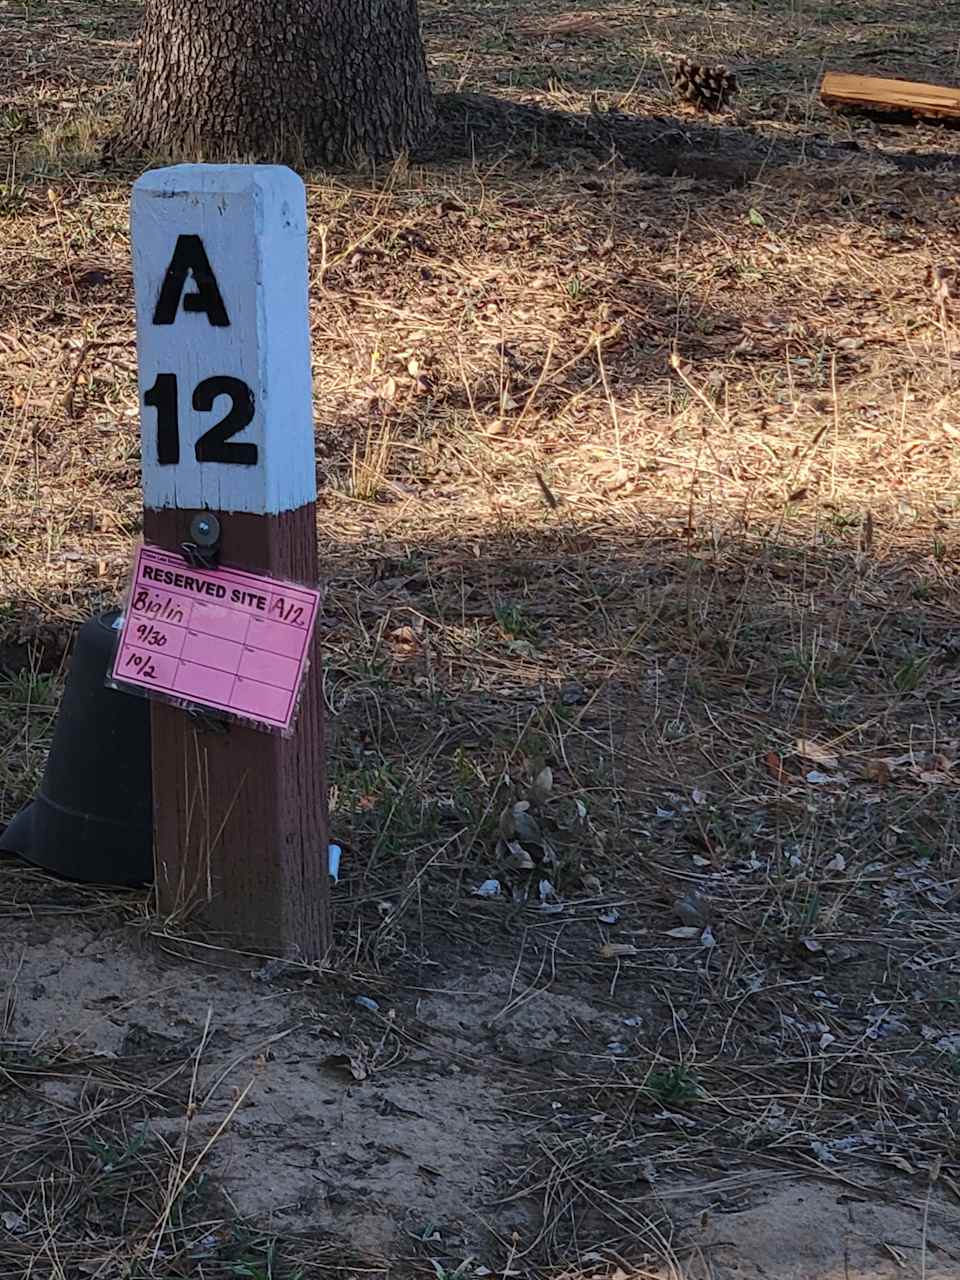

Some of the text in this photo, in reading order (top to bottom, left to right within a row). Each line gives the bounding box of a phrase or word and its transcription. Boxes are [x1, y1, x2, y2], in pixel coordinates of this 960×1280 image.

[152, 234, 231, 327] A
[144, 373, 258, 465] 12
[142, 565, 268, 611] RESERVED SITE
[271, 597, 306, 626] A12
[136, 623, 167, 647] 9/30
[125, 653, 159, 679] 10/2
